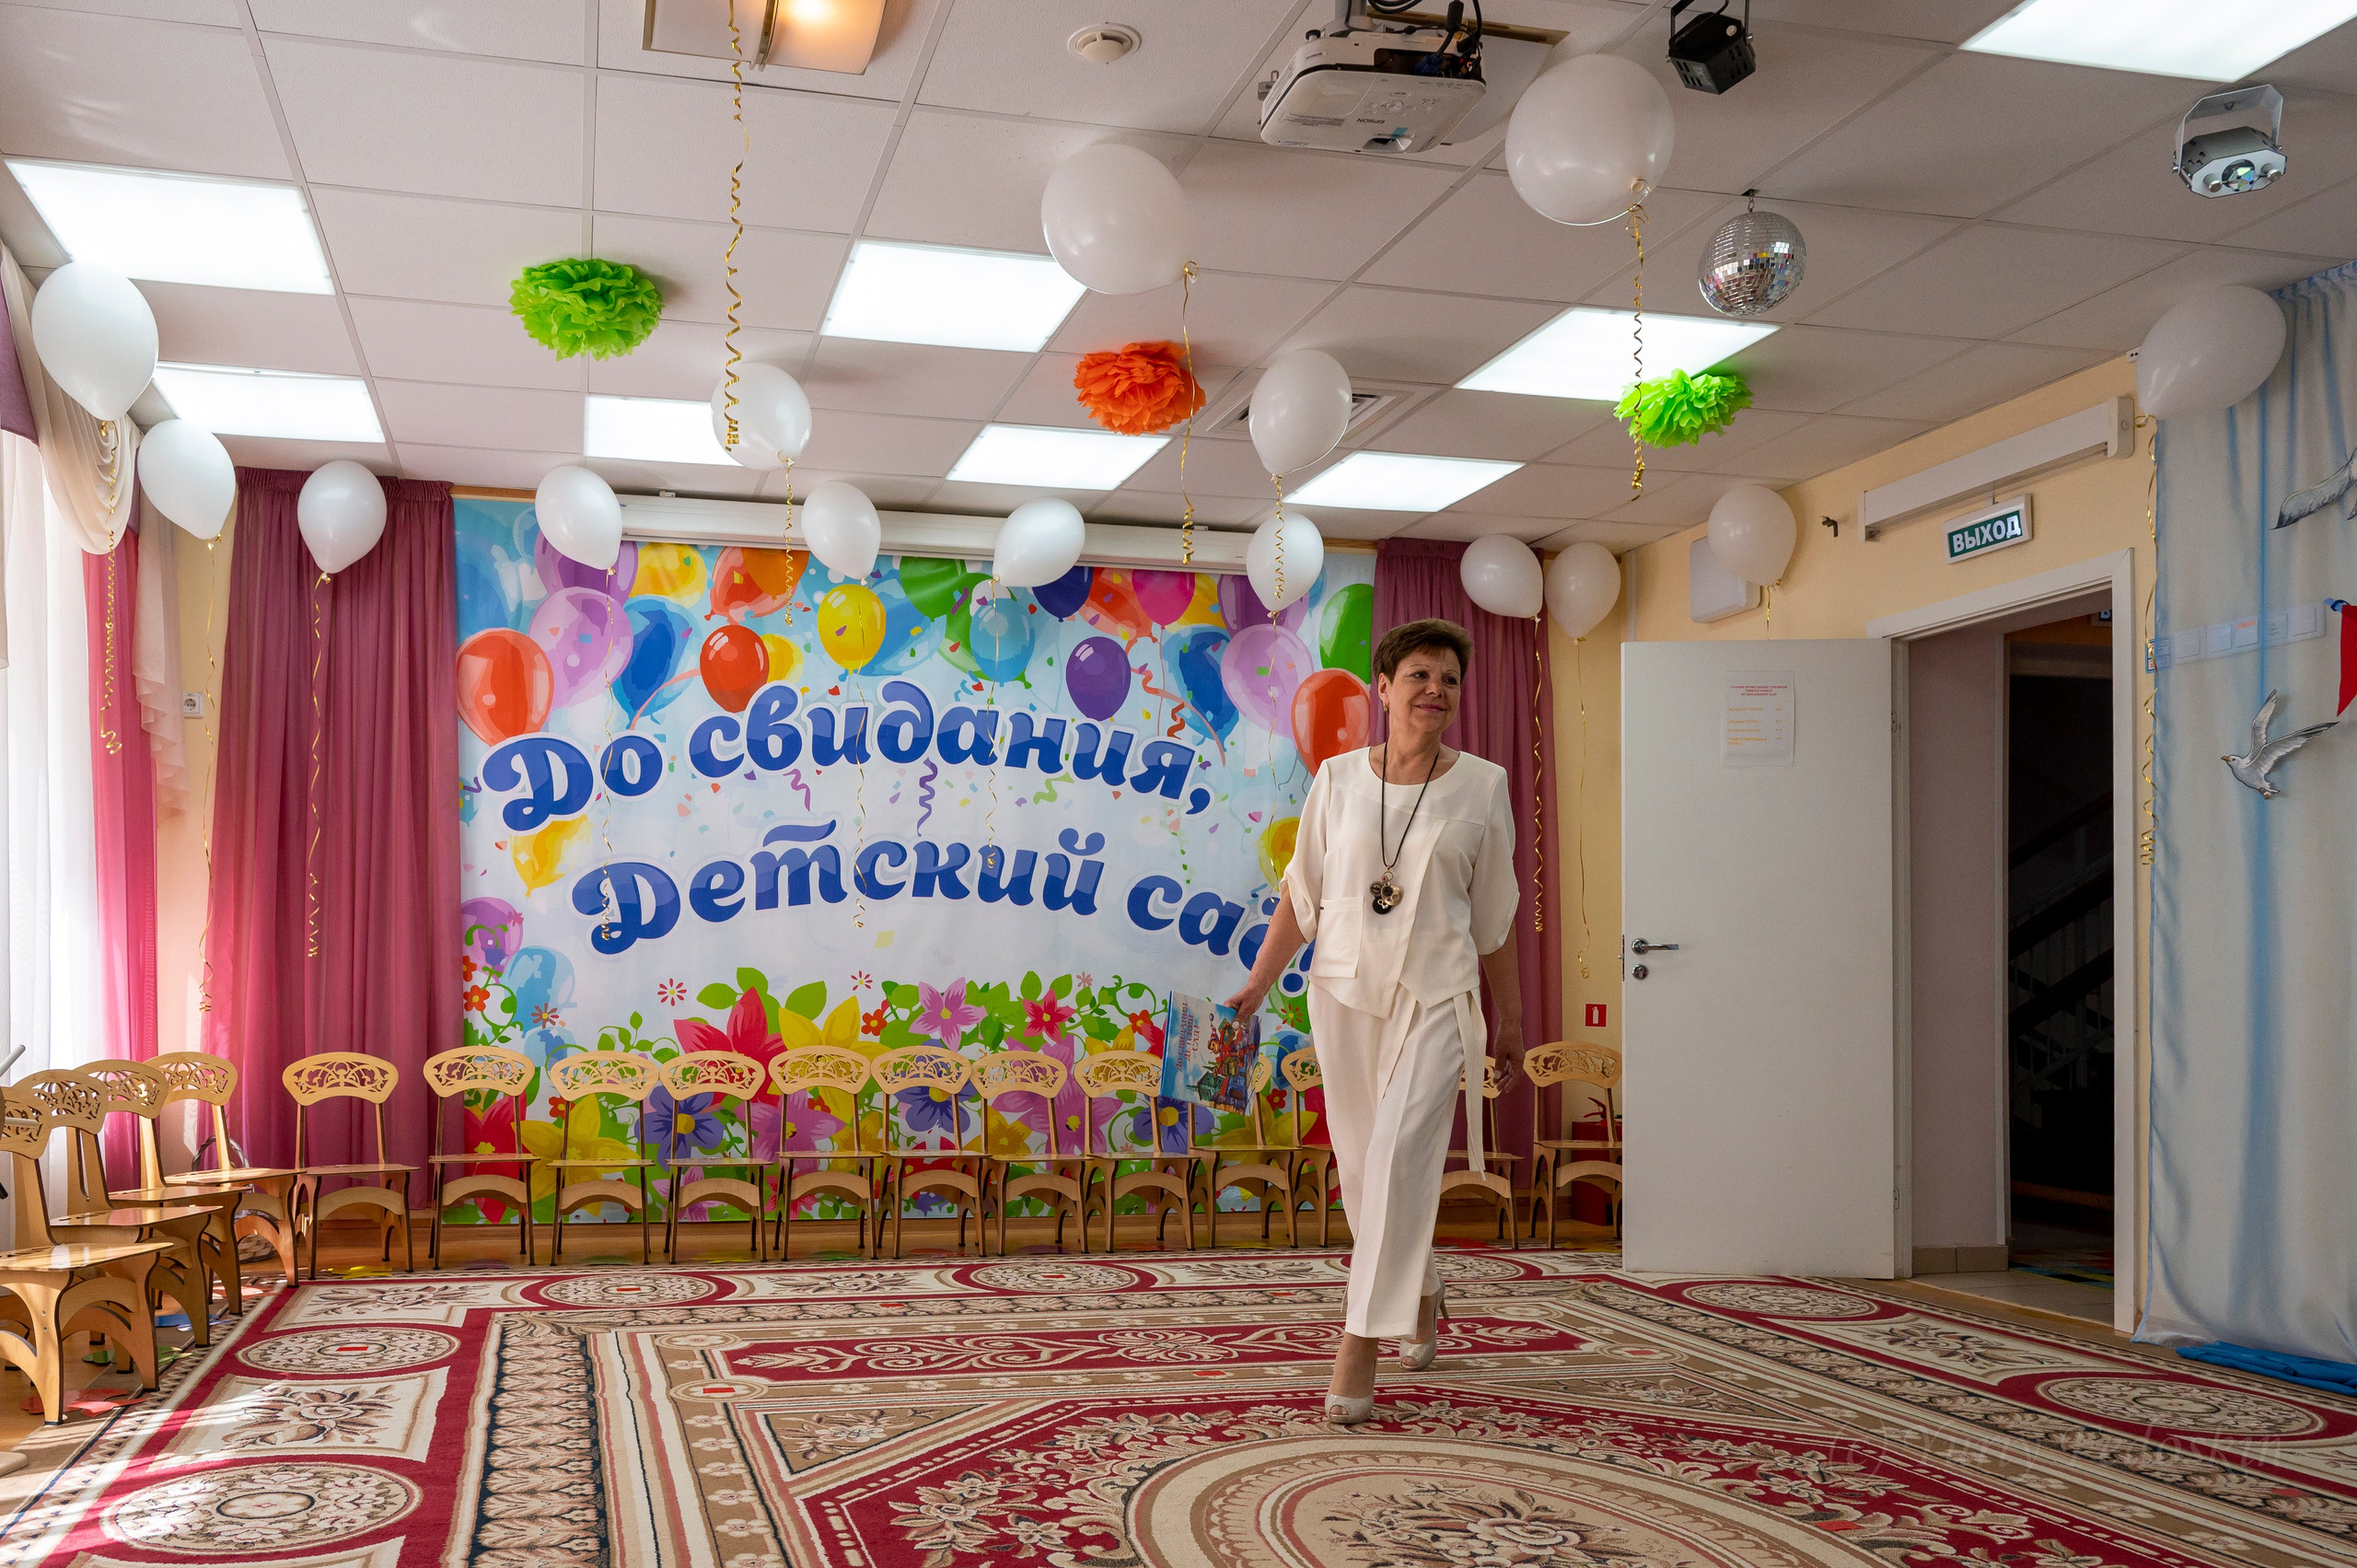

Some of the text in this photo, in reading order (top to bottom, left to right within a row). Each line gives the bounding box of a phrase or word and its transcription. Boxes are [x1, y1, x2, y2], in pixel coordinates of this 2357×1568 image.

[1952, 515, 2022, 553] ВЫХОД
[482, 680, 1213, 831] До свидания,
[572, 819, 1106, 955] Детский
